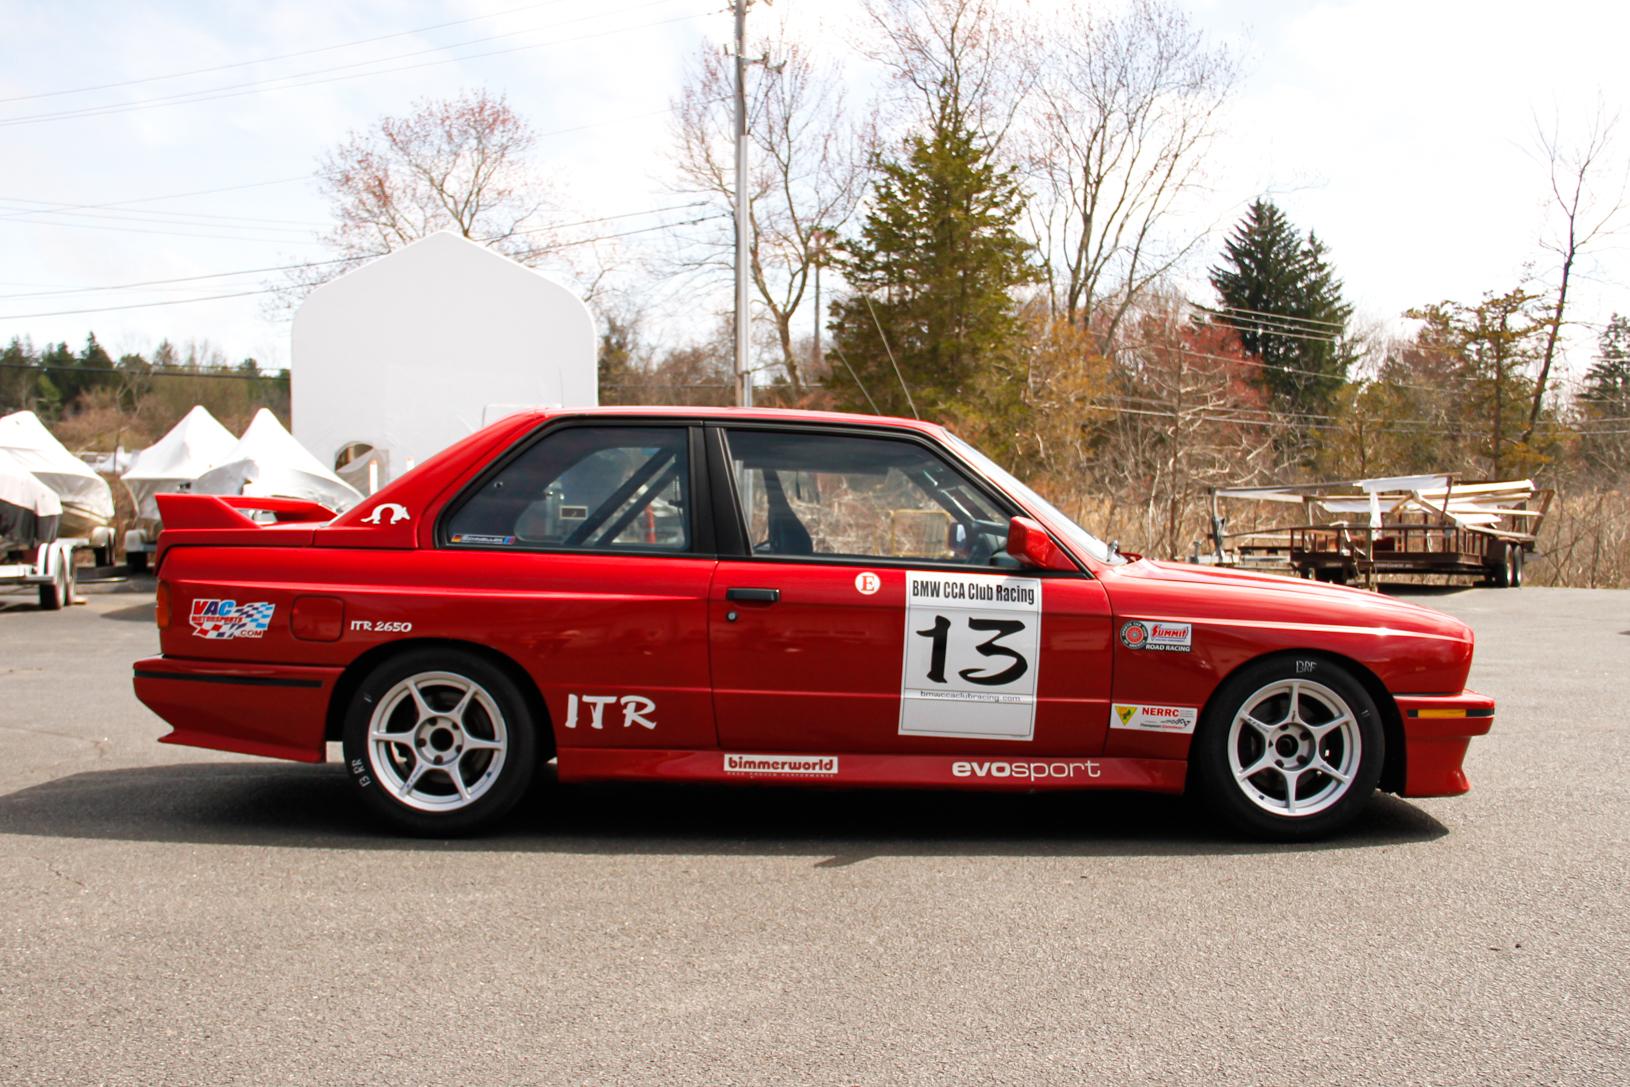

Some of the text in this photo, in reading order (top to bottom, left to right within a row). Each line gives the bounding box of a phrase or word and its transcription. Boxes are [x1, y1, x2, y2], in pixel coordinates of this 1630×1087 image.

[860, 575, 875, 592] E
[912, 580, 1035, 605] BMW CCA Club Racing
[193, 600, 235, 615] VAC
[350, 620, 413, 632] ITR 2650
[916, 615, 1028, 686] 13
[565, 693, 657, 729] ITR
[1142, 707, 1179, 717] NERRC
[728, 756, 834, 771] bimmerworld
[952, 760, 1100, 782] evosport
